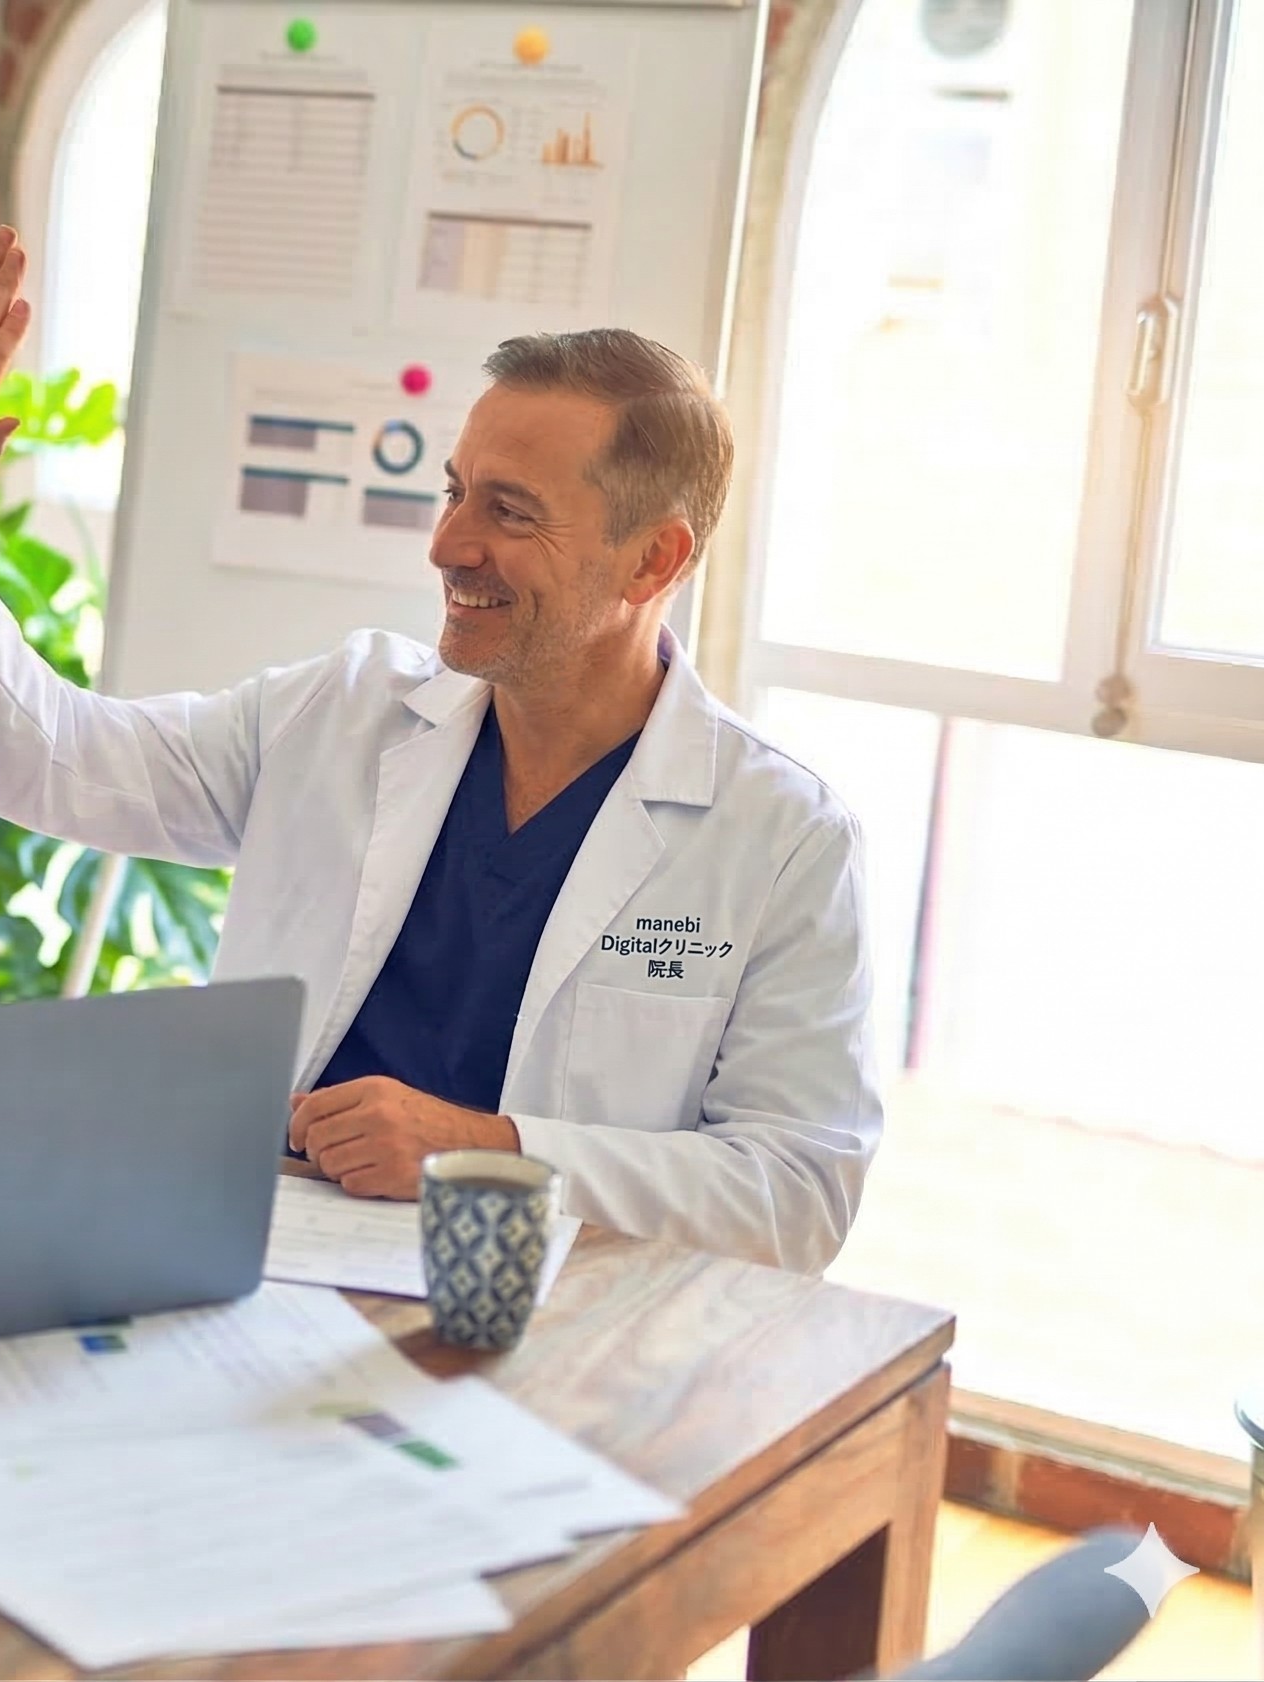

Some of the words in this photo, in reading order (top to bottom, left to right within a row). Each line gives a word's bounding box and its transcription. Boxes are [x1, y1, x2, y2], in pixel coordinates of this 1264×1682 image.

[636, 916, 701, 933] manebi
[601, 935, 733, 958] Digitalクリニック
[647, 959, 685, 979] 院長
